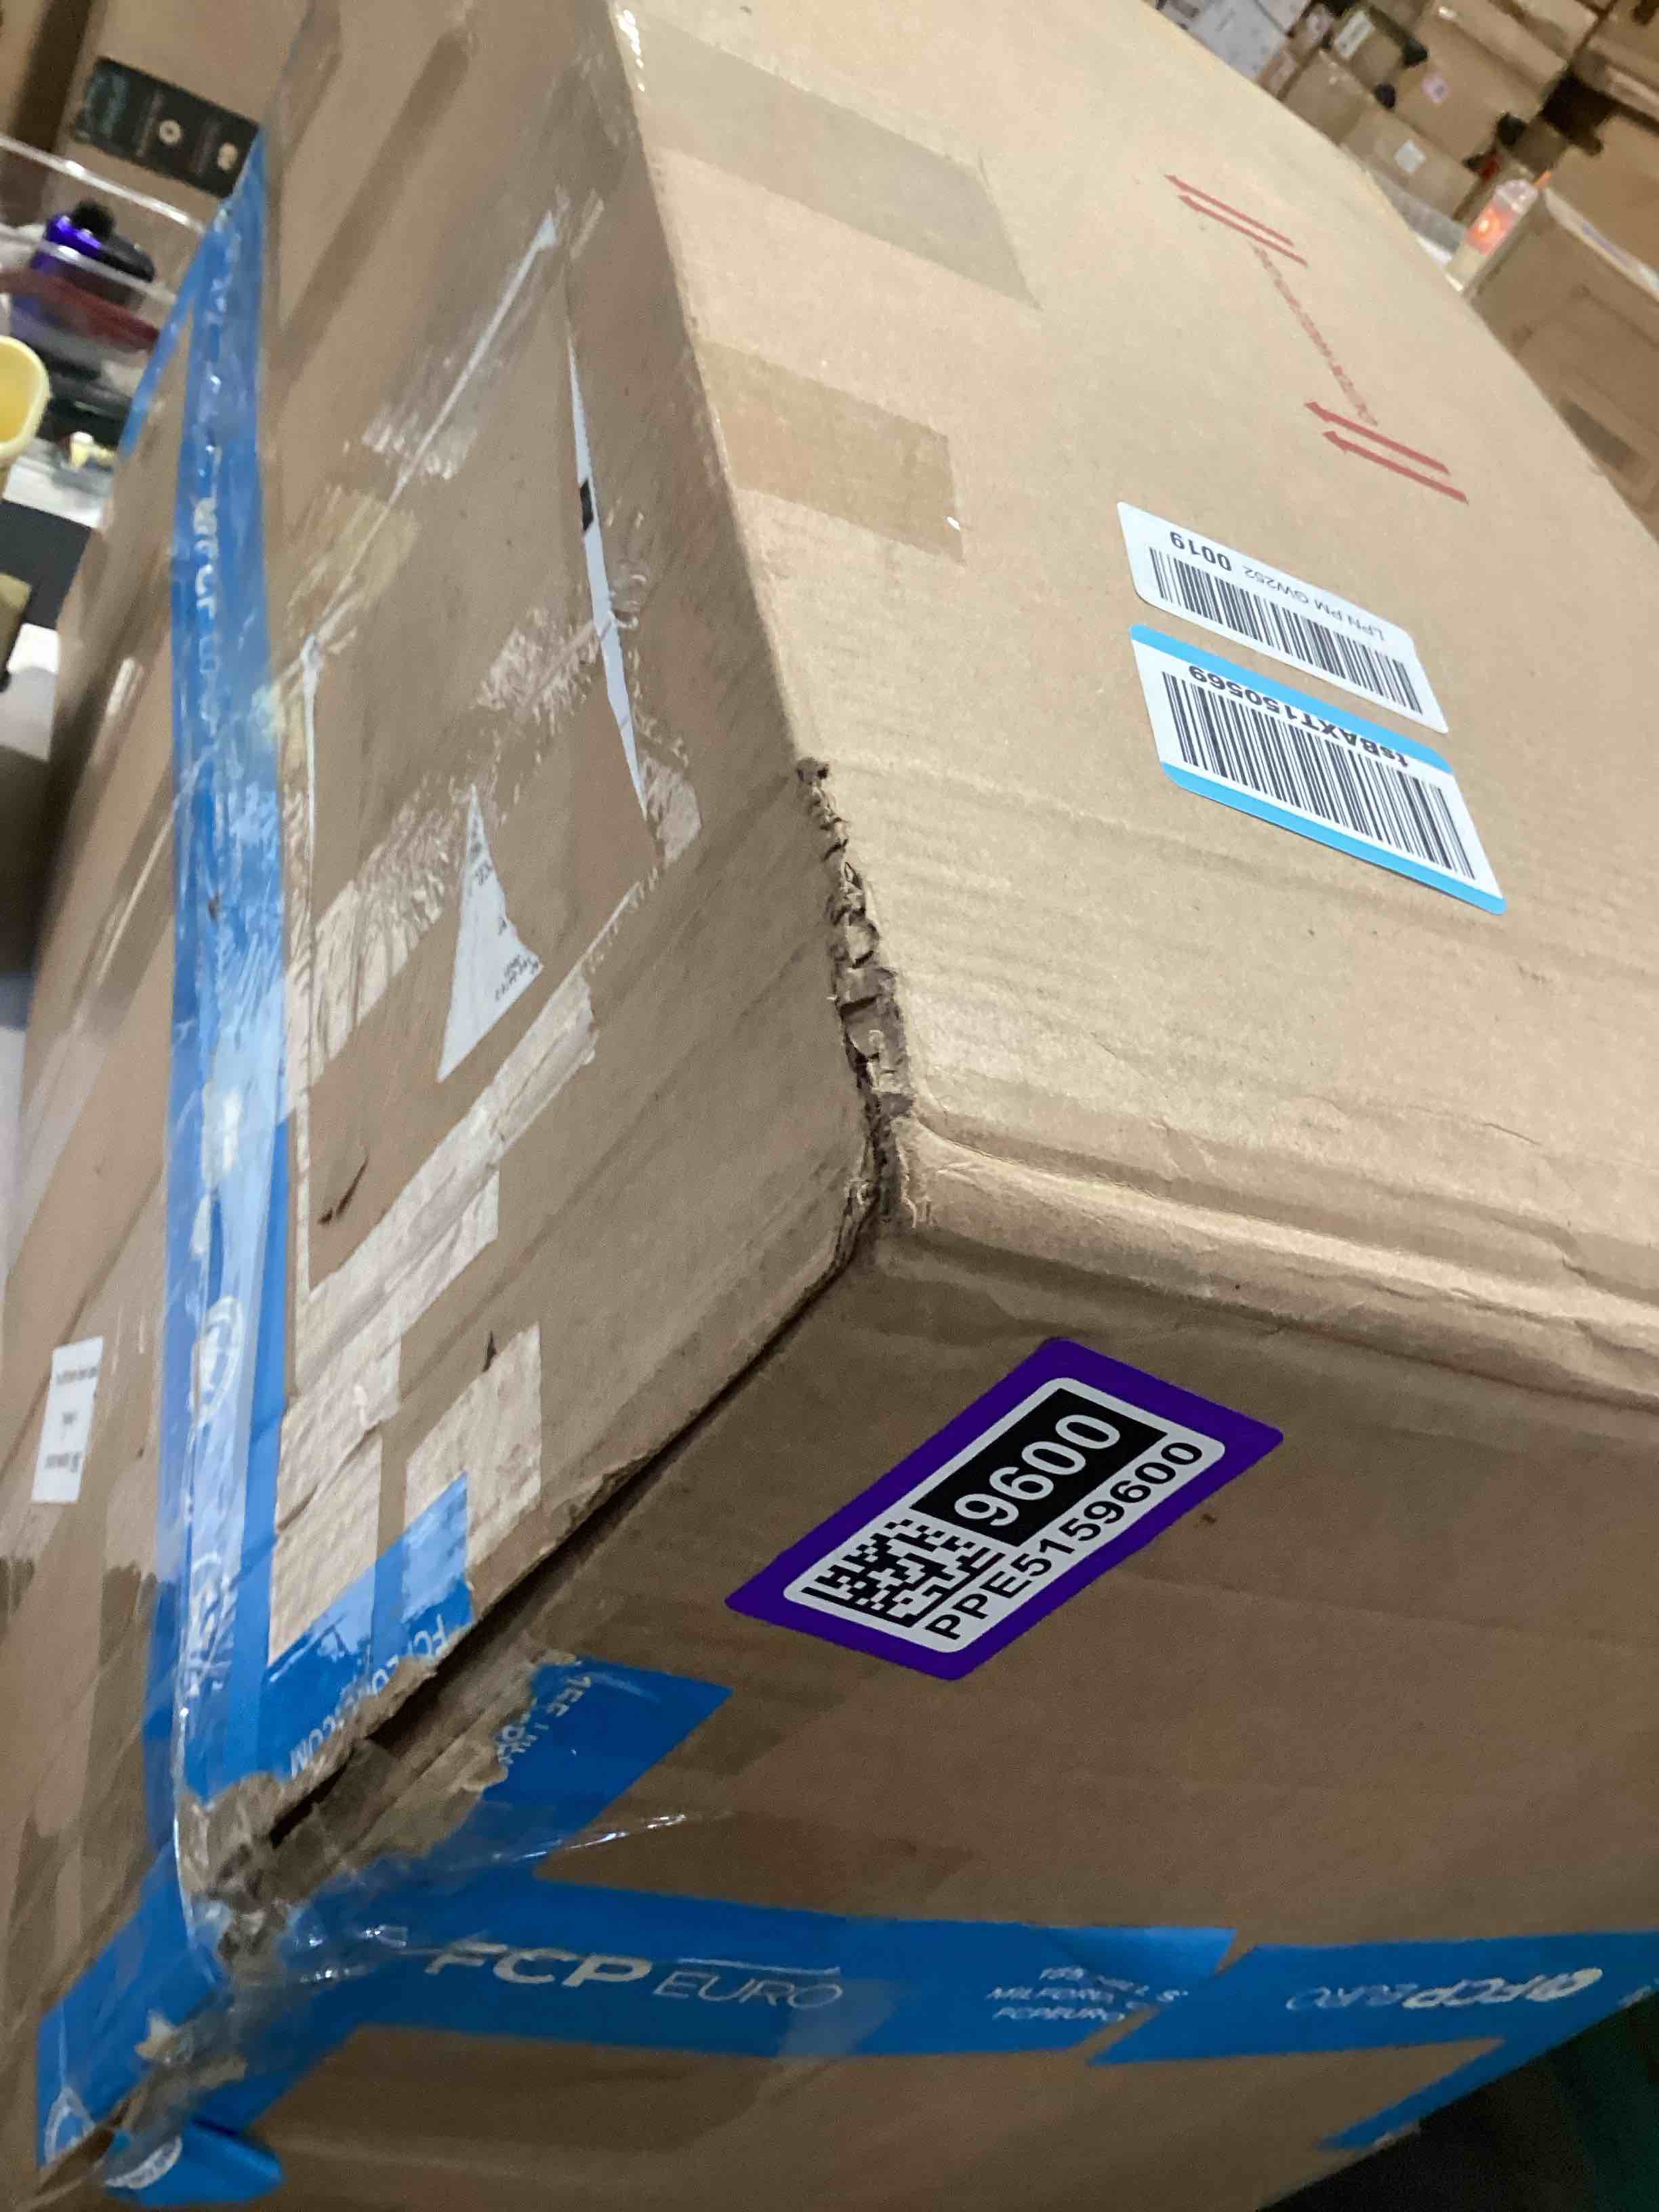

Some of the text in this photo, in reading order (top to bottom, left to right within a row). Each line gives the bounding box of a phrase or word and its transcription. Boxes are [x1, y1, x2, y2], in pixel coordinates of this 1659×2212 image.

[1169, 531, 1232, 571] 0019
[1313, 599, 1343, 621] PM
[1347, 615, 1385, 641] LPN
[1188, 664, 1408, 767] tsBAXT150569
[954, 1414, 1122, 1528] 9600
[928, 1441, 1204, 1640] PPE5159600
[424, 1940, 844, 2010] FCP EURO
